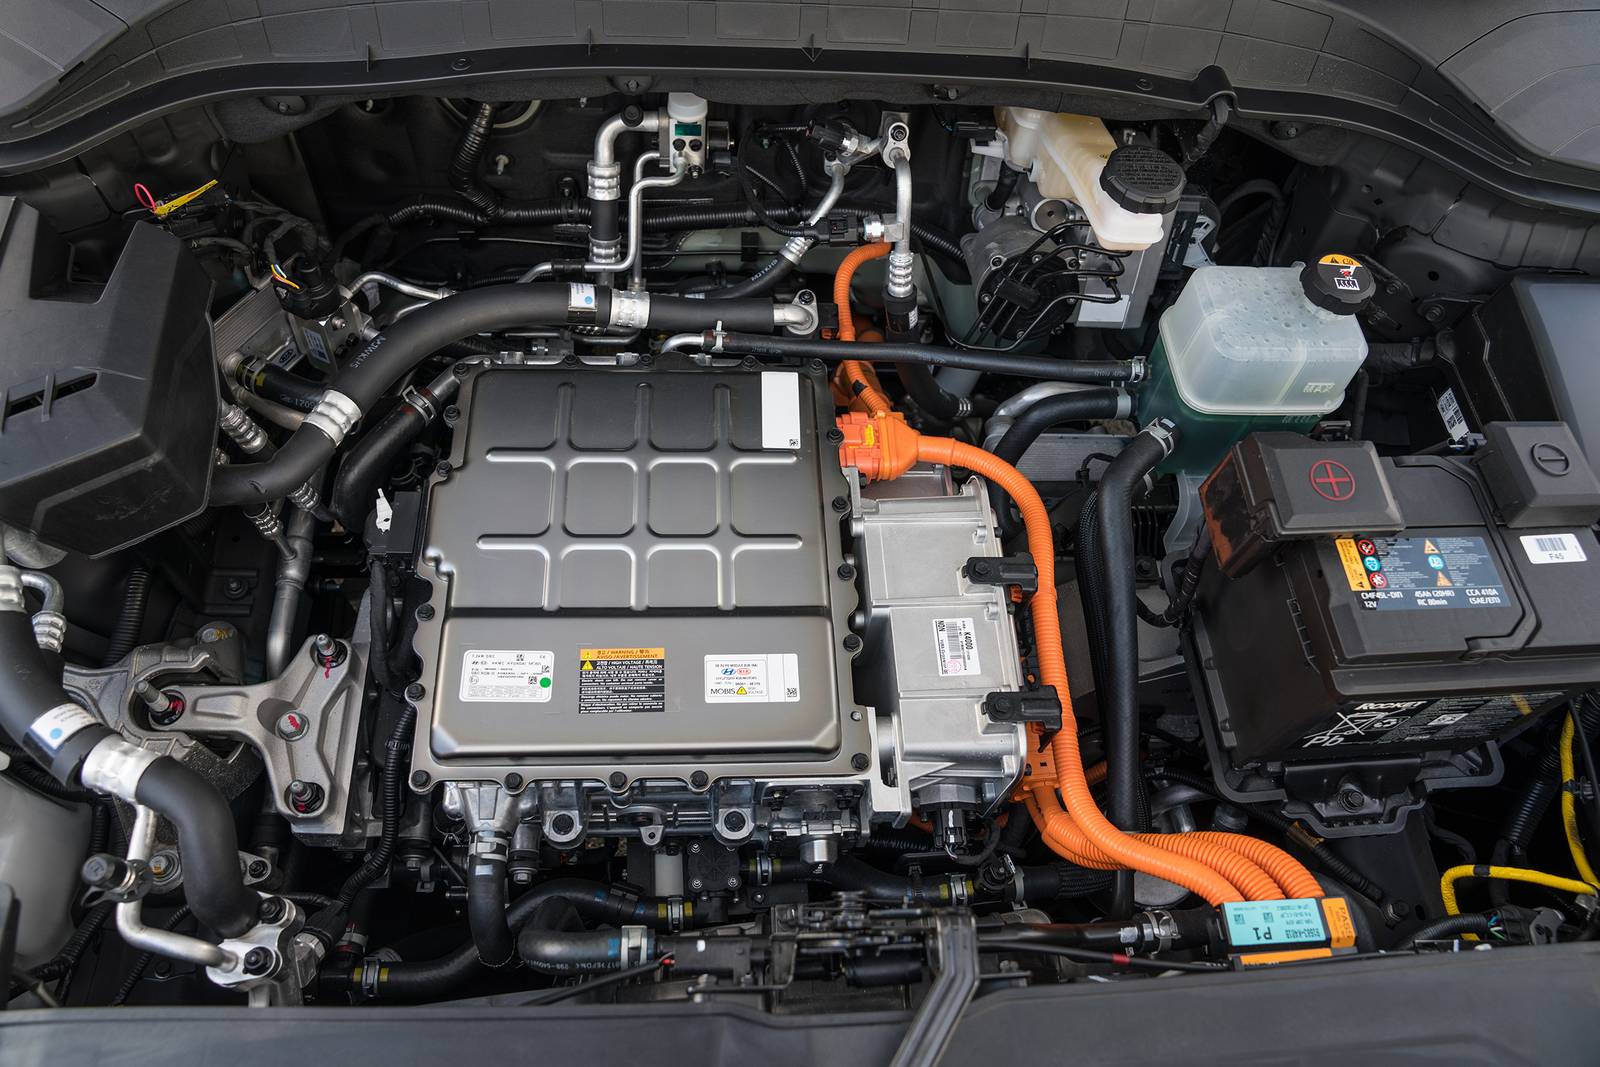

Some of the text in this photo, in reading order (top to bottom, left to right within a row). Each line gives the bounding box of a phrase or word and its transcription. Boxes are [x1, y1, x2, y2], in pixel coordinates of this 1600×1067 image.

[1466, 588, 1480, 597] CCA
[1364, 600, 1377, 608] 12V
[1354, 701, 1428, 711] ROCKET
[1302, 735, 1345, 748] Pb
[1252, 926, 1273, 941] P1
